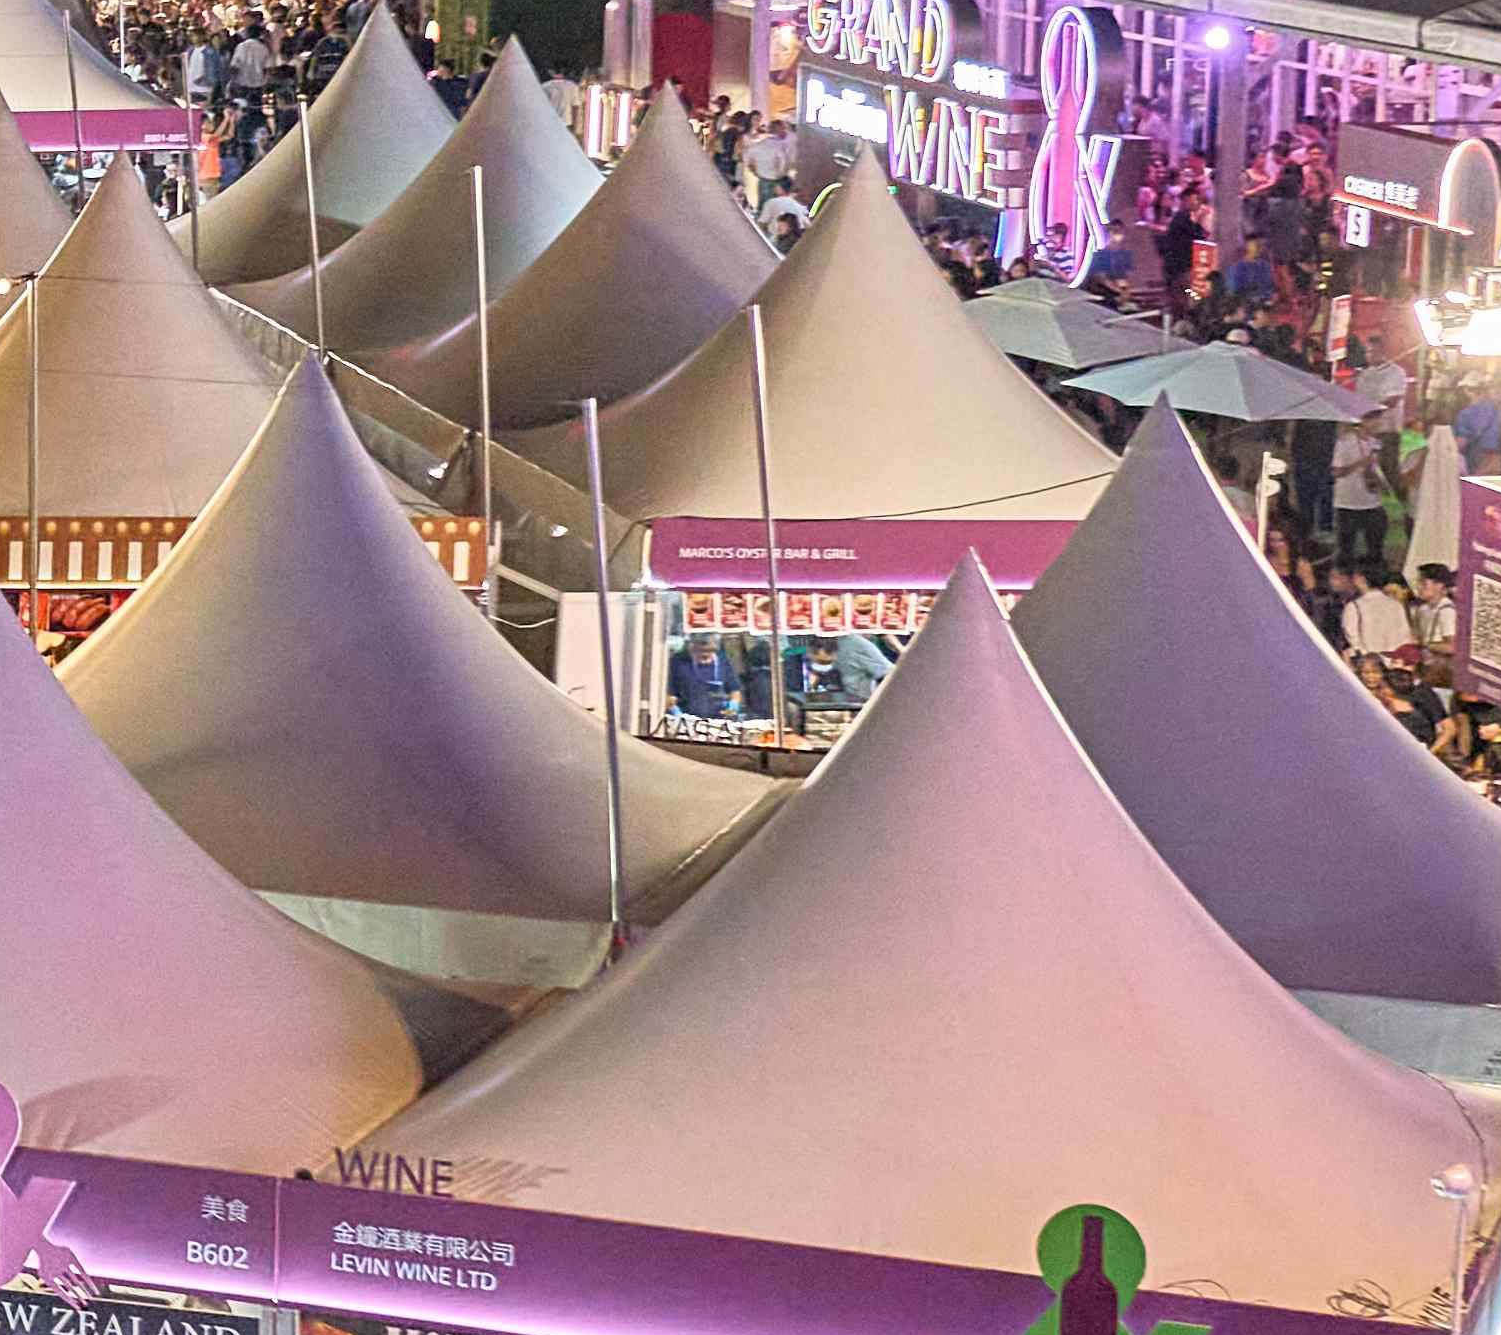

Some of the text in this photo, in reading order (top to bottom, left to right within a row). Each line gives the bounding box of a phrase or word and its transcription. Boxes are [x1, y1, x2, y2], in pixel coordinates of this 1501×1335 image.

[886, 84, 1008, 208] WINE
[737, 547, 780, 559] OYSTR
[335, 1147, 454, 1198] WINE
[200, 1194, 249, 1223] 美食
[187, 1240, 249, 1270] B602
[330, 1252, 498, 1291] LEVIN WINE LTD
